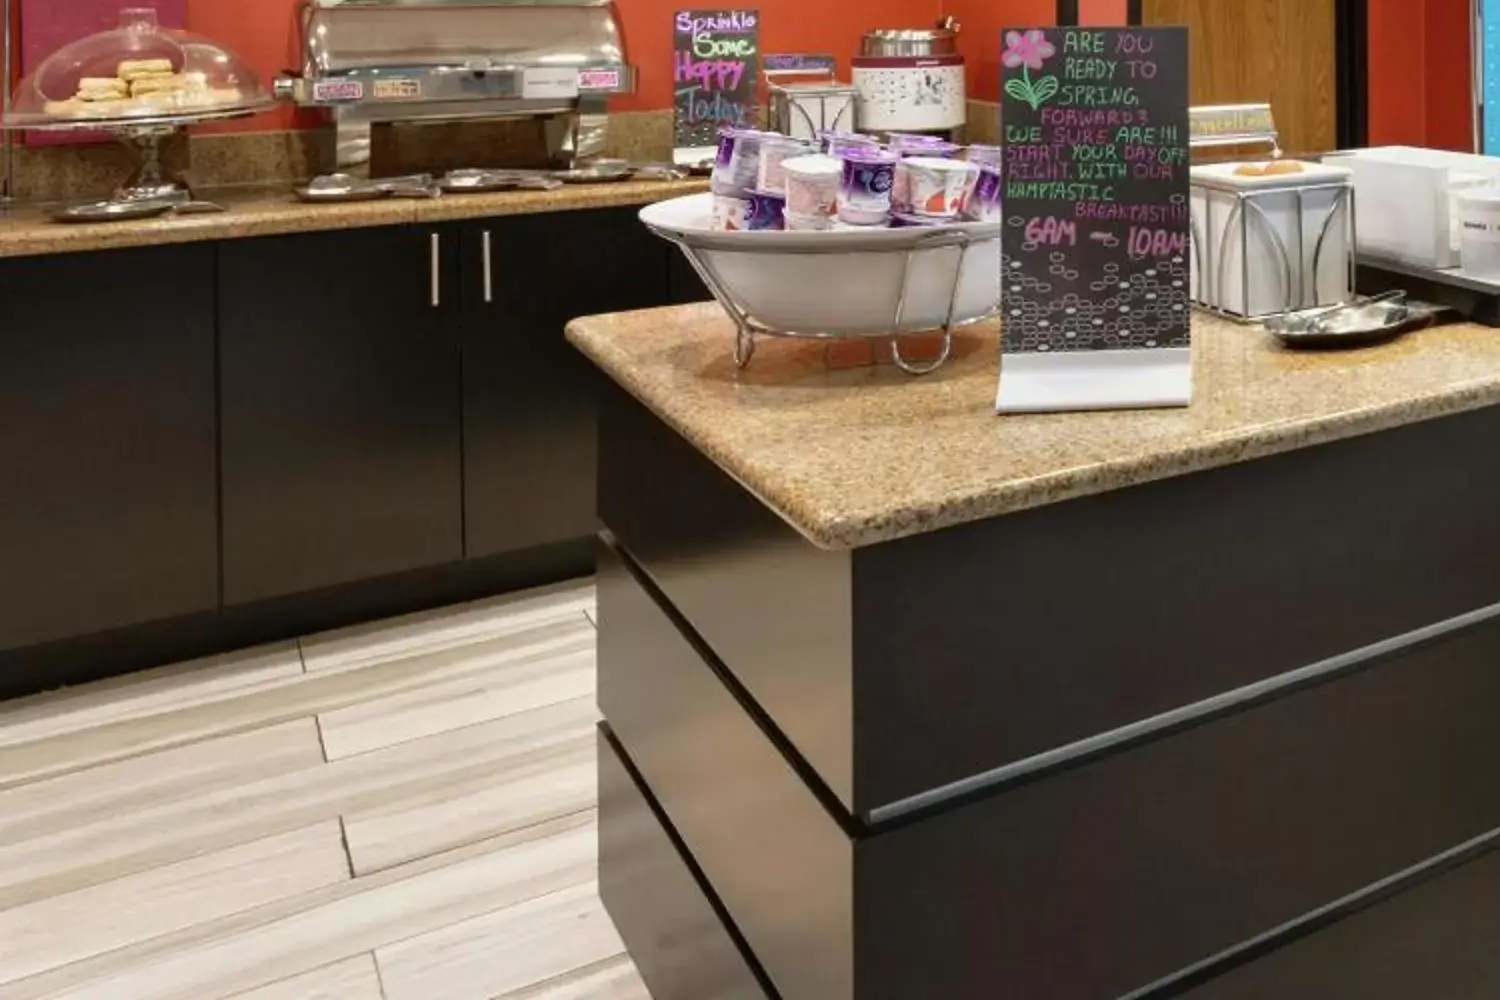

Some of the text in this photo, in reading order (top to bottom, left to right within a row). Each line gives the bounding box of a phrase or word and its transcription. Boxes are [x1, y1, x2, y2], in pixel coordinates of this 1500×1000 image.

[1063, 31, 1153, 53] ARE YOU
[674, 50, 745, 92] Happy
[1065, 57, 1157, 80] READY TO
[1058, 85, 1139, 106] SPRING
[674, 85, 746, 130] Today
[1006, 125, 1042, 142] WE
[1052, 127, 1109, 145] SURE
[1006, 144, 1190, 166] START YOUR DAY OFF
[1077, 163, 1127, 179] WITH
[1133, 163, 1173, 180] OUR
[1006, 181, 1114, 201] HAMPTASTIC
[1025, 215, 1077, 248] 6AM
[1126, 225, 1190, 256] 10AM
